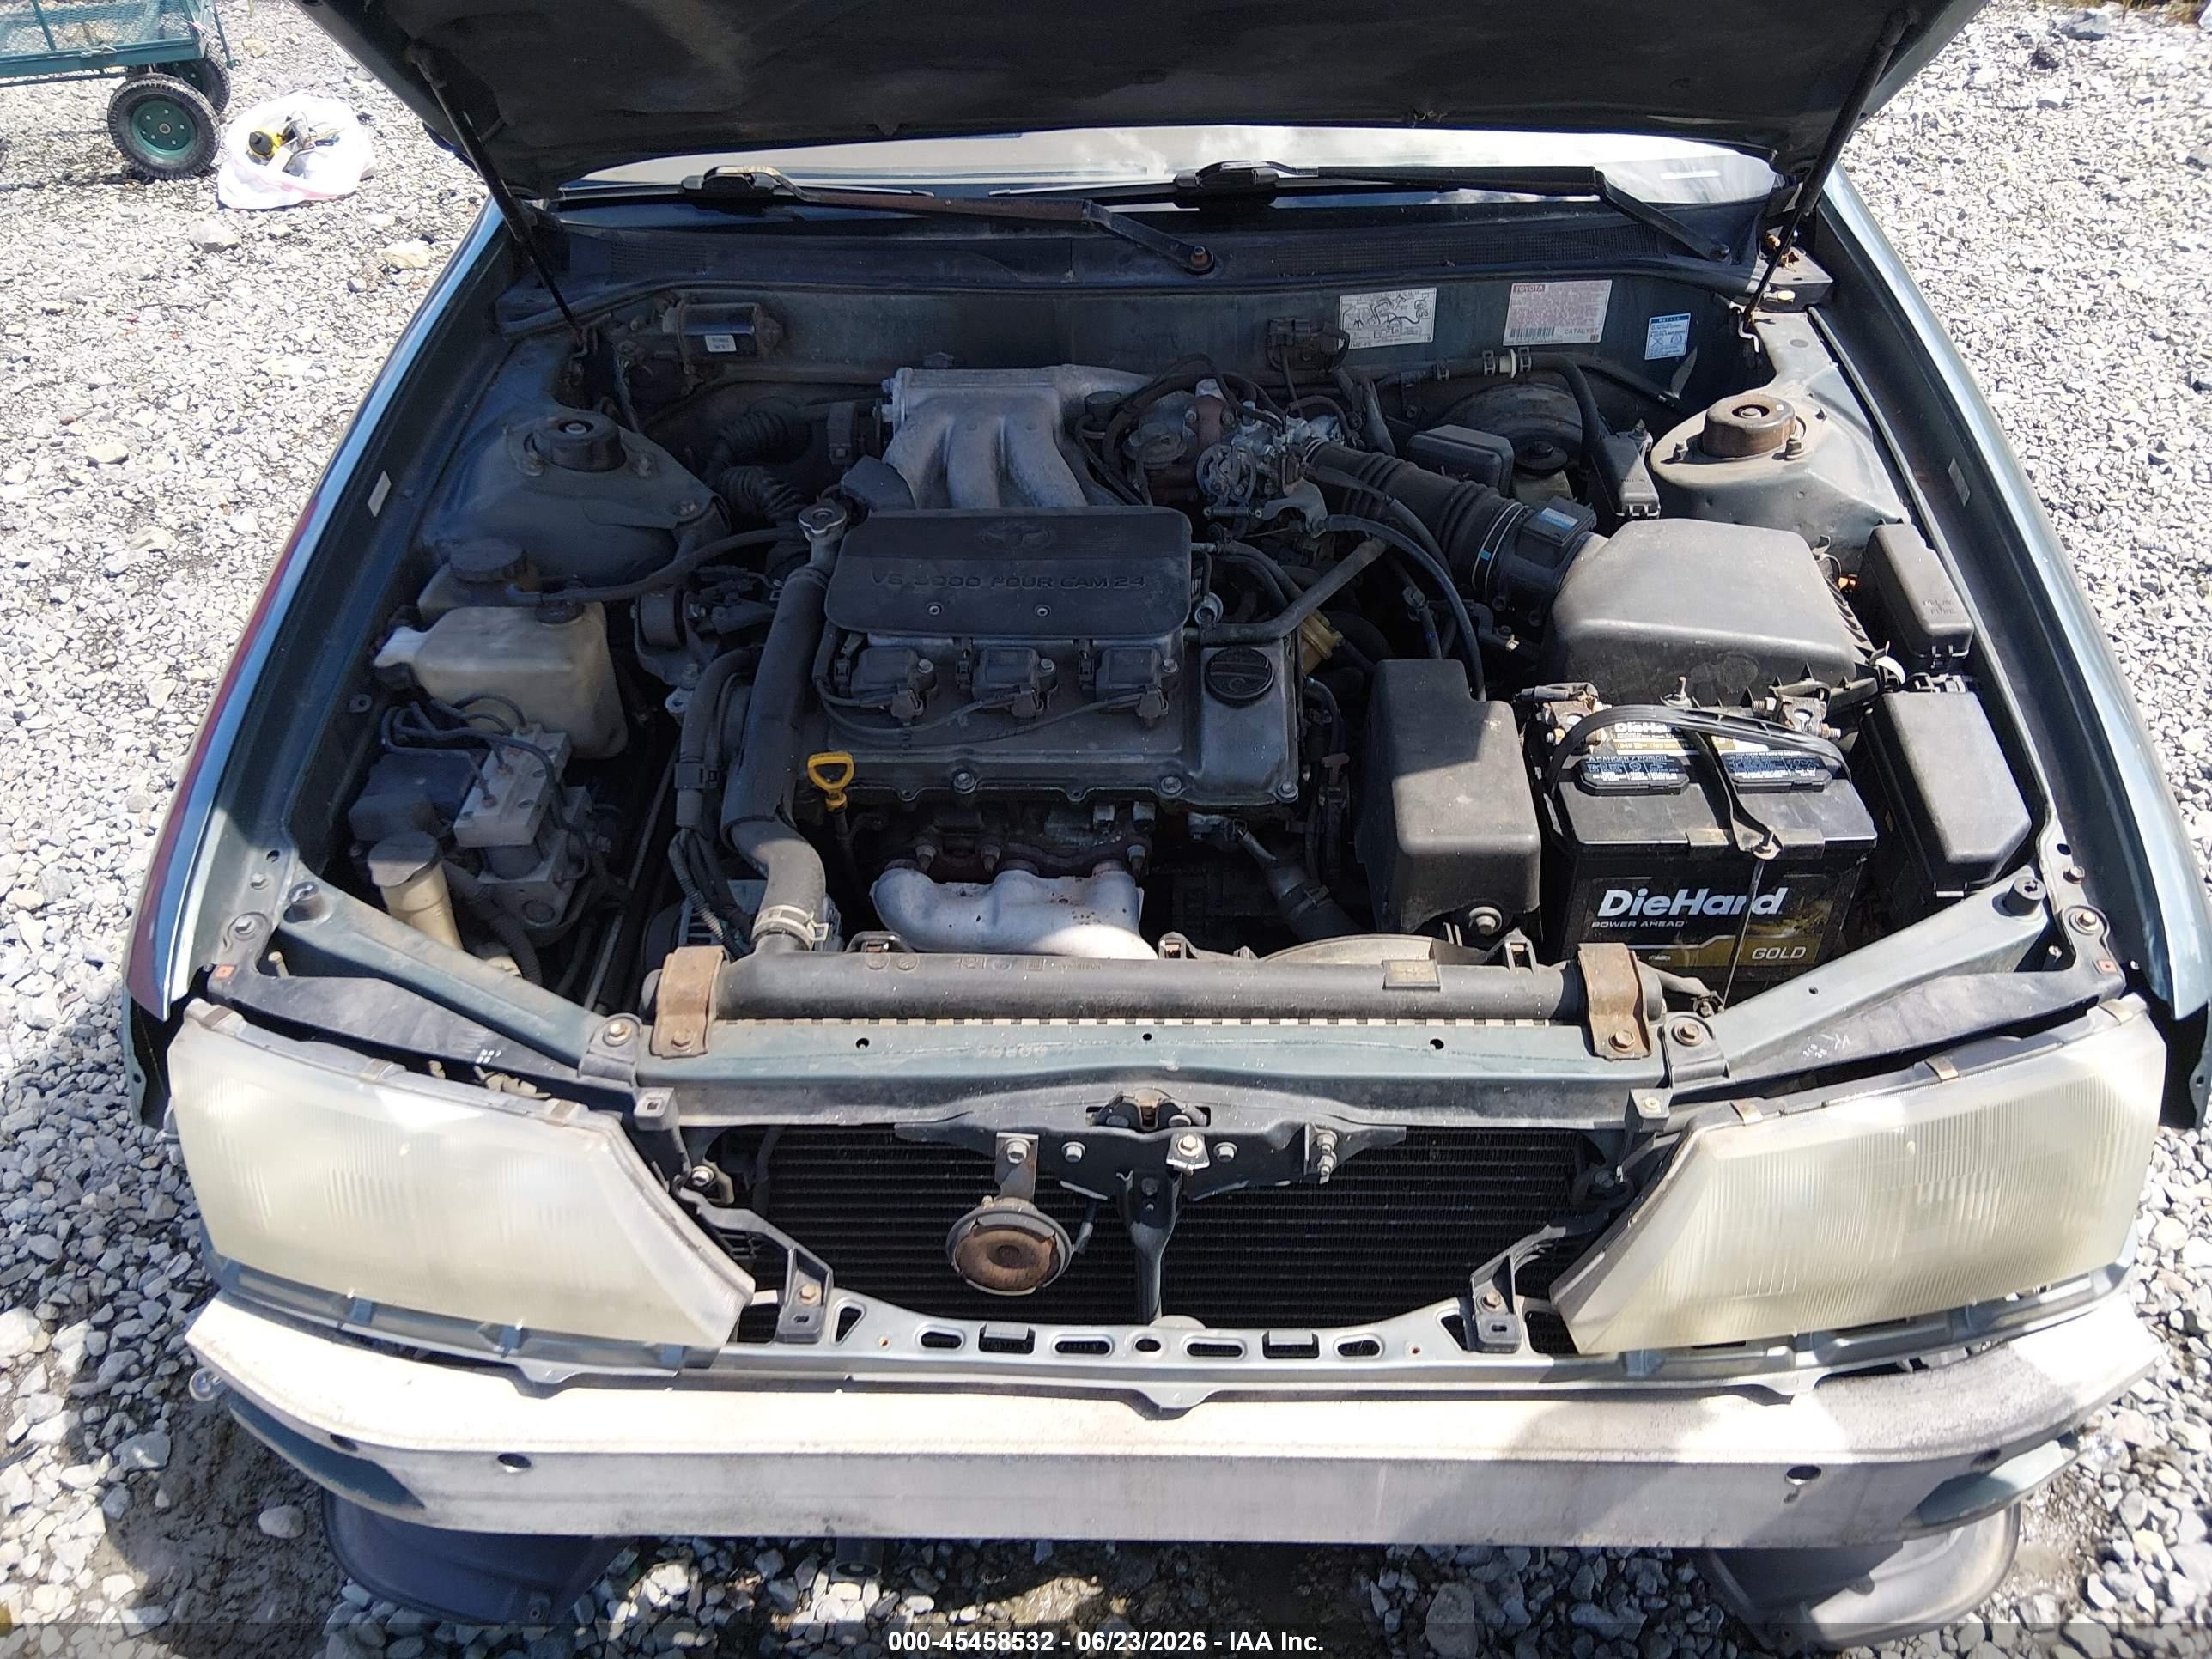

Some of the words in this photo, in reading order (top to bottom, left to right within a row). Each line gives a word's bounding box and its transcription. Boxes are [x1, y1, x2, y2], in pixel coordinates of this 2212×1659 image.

[990, 576, 1054, 588] FOUR
[1060, 576, 1109, 589] CAM
[1112, 576, 1146, 588] 24
[1597, 887, 1789, 917] DieHard
[1751, 946, 1807, 960] GOLD
